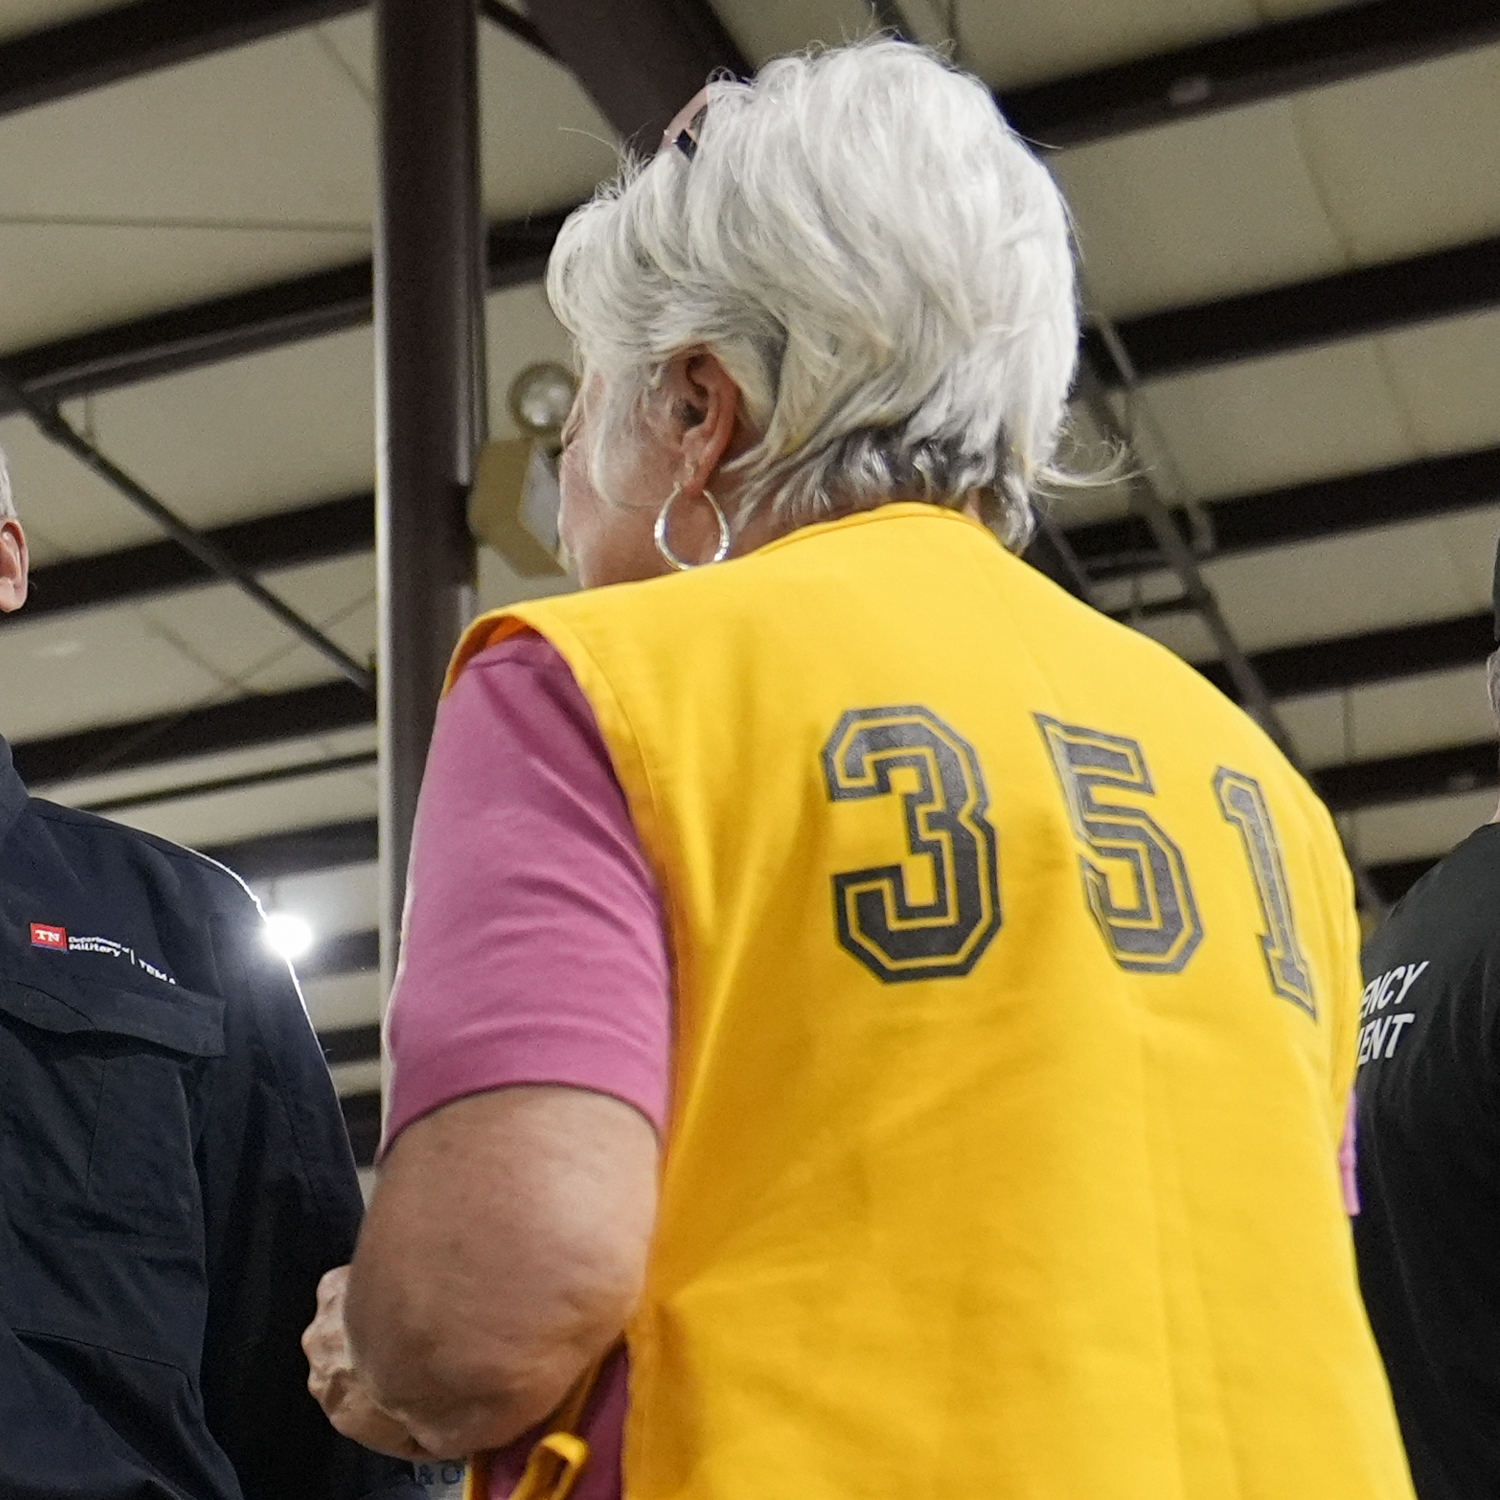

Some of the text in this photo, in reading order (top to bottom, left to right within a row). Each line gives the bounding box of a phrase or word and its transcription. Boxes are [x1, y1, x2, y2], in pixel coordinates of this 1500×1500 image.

[820, 704, 1318, 1024] 351
[34, 929, 62, 943] TN
[68, 936, 121, 949] Department
[69, 943, 121, 957] Military
[138, 958, 176, 985] TEMA
[1360, 961, 1430, 1021] ENCY
[1356, 1012, 1416, 1068] ENT
